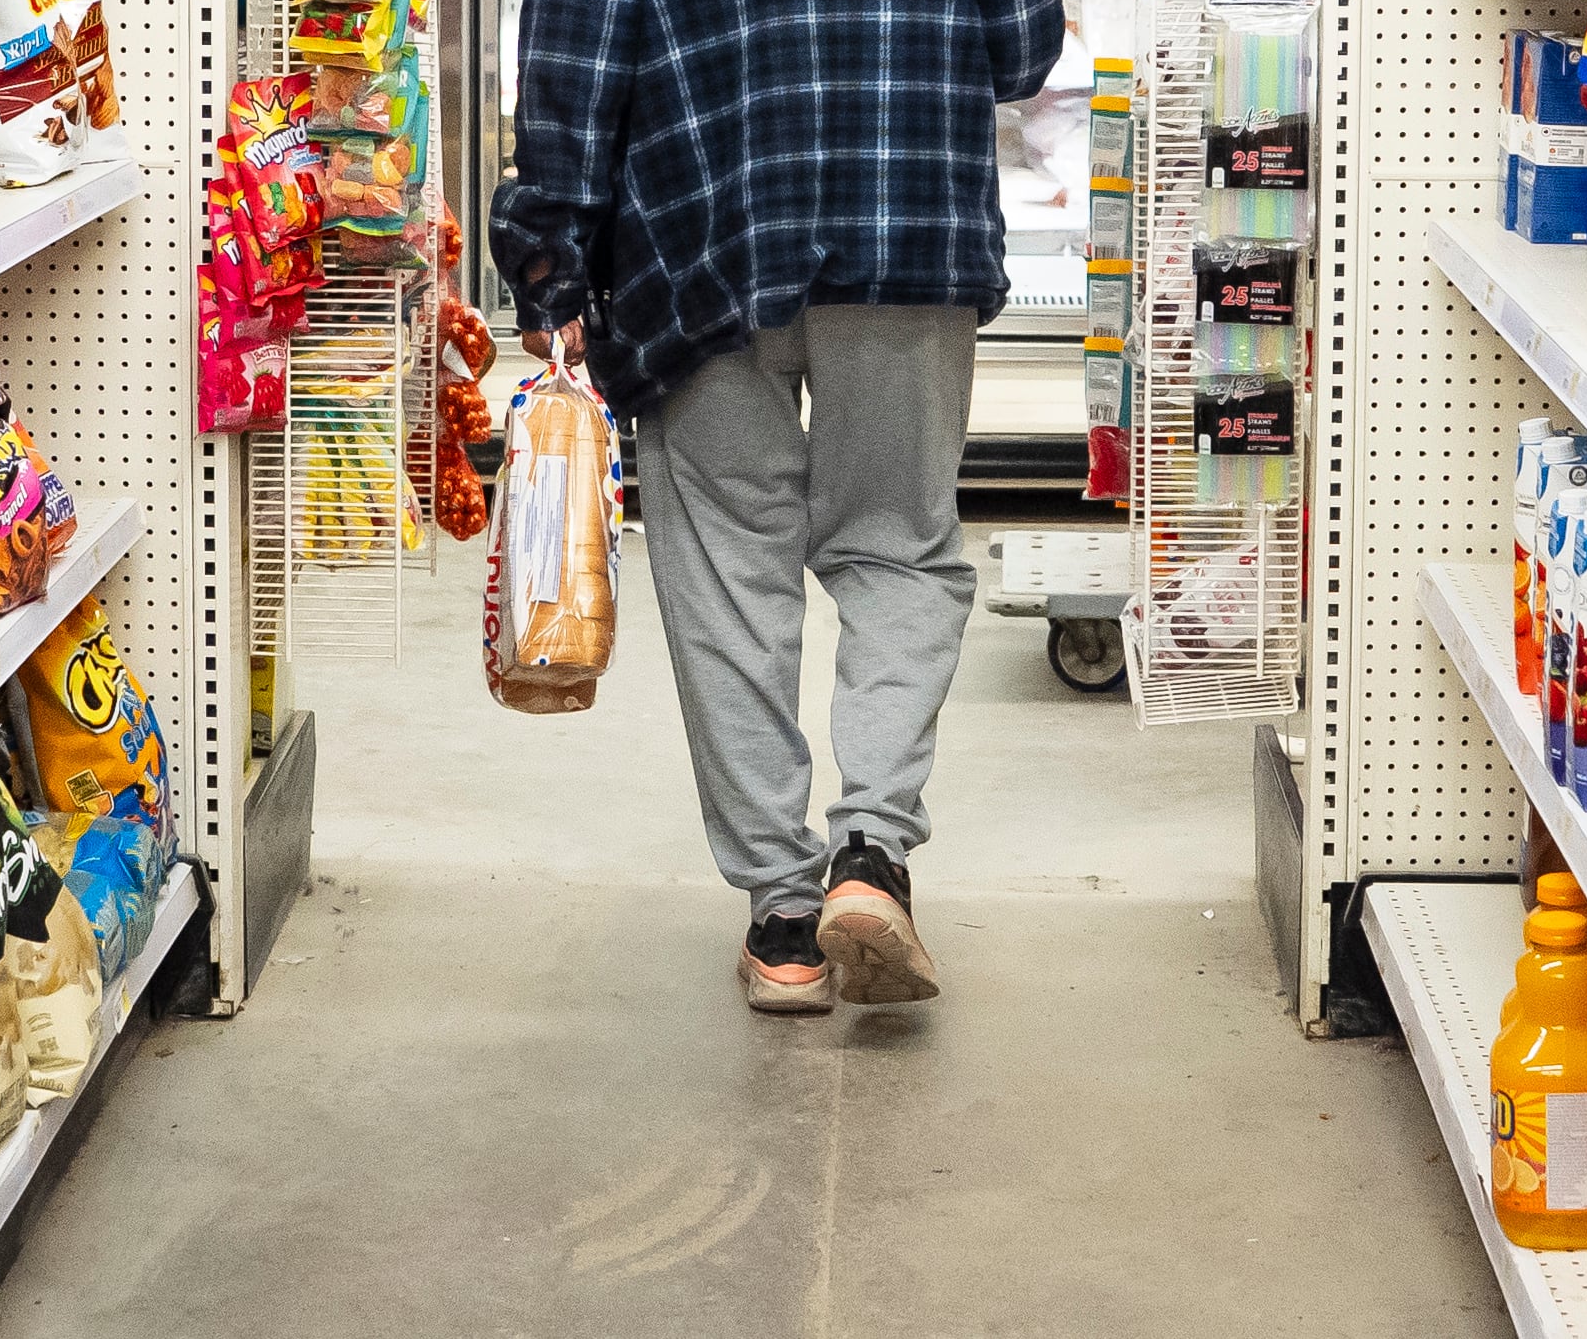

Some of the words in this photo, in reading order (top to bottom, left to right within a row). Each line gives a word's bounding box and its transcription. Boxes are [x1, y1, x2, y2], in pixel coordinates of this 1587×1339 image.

[1232, 150, 1260, 173] 25
[1221, 285, 1249, 306] 25
[1218, 417, 1246, 438] 25
